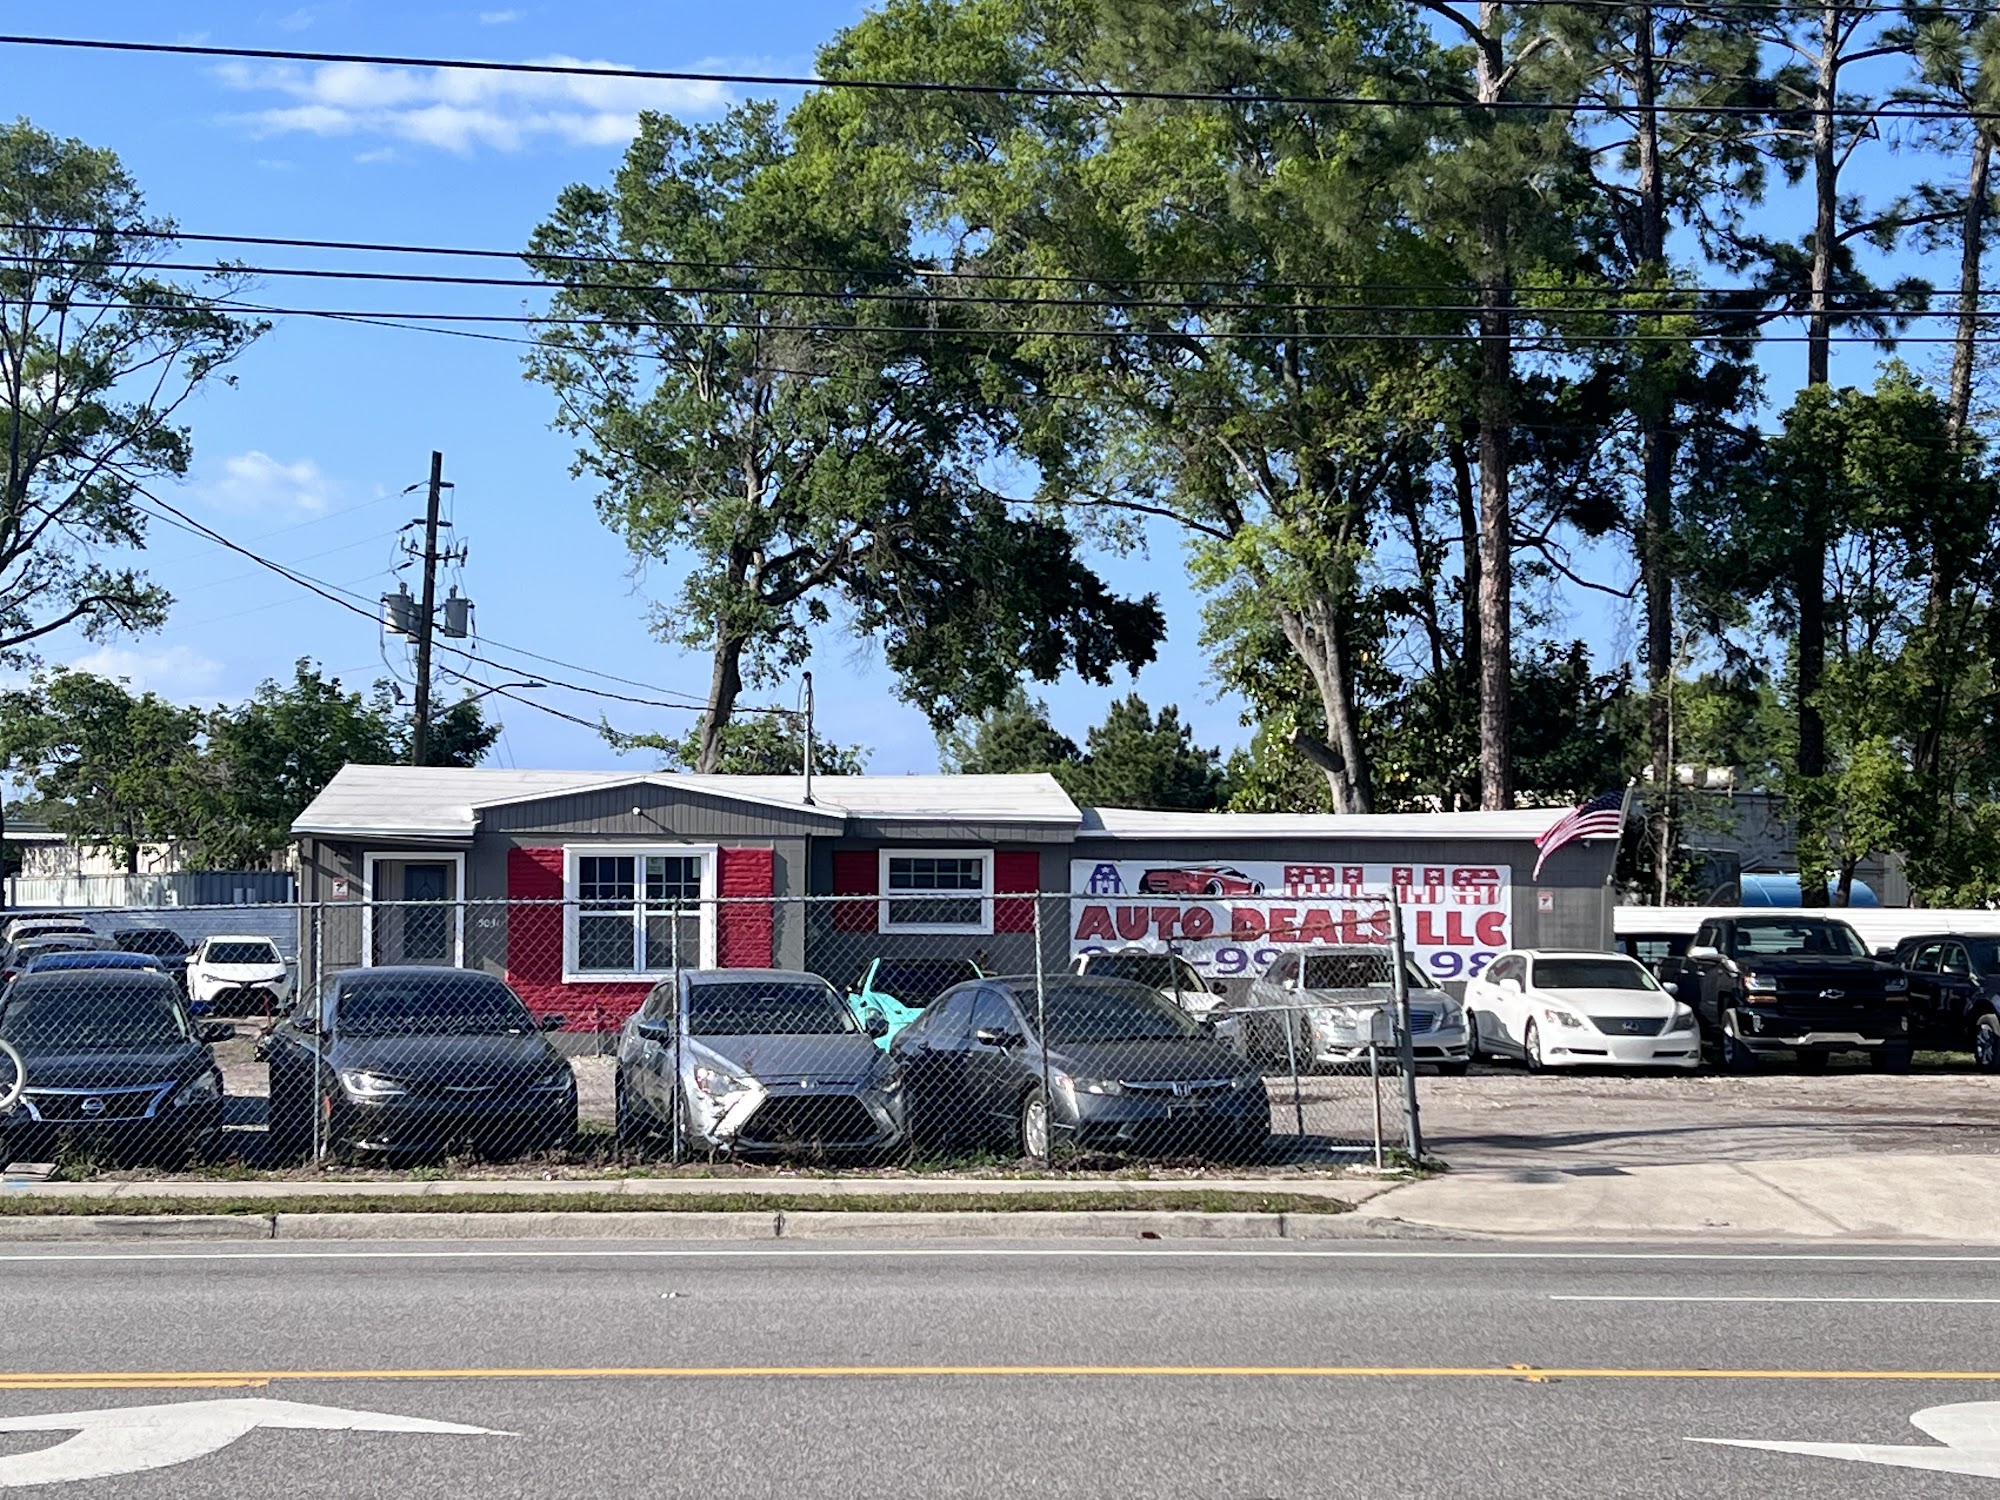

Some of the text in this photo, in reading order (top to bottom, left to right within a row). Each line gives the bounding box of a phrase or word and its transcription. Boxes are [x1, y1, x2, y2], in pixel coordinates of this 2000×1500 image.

[1084, 863, 1128, 895] A
[1284, 865, 1501, 905] PLUS
[1074, 905, 1507, 946] AUTO DEALS LLC
